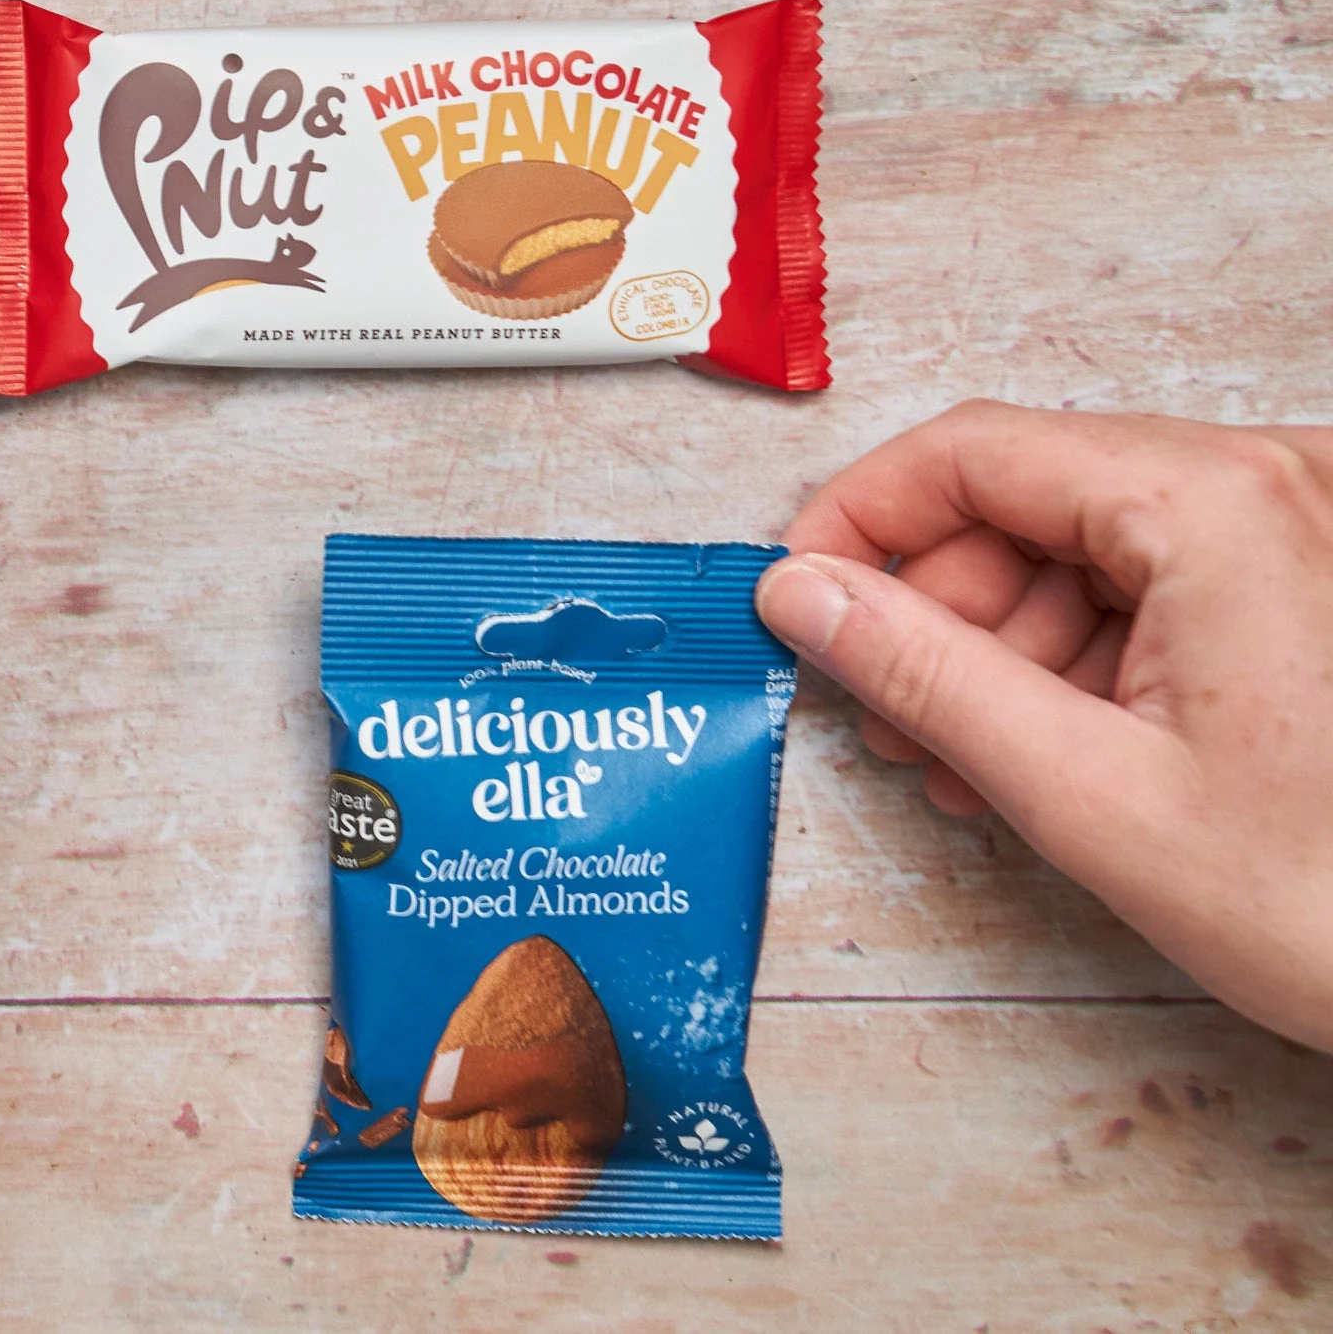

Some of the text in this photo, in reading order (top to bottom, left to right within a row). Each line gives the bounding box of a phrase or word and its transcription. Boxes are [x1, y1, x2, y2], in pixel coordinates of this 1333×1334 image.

[363, 50, 707, 139] MILK CHOCOLATE
[99, 53, 304, 251] Pip
[303, 86, 347, 139] &
[380, 90, 700, 215] PEANUT
[162, 148, 328, 256] Nut
[617, 283, 646, 322] ETHICAL
[243, 328, 562, 342] MADE WITH REAL PEANUT BUTTER
[501, 658, 598, 686] plant-based
[357, 690, 706, 766] deliciously
[472, 761, 588, 823] ella
[328, 806, 396, 843] aste
[336, 855, 359, 868] 2021
[415, 844, 667, 883] Salted Chocolate
[386, 880, 690, 928] Dipped Almonds
[668, 1101, 749, 1129] NATURAL
